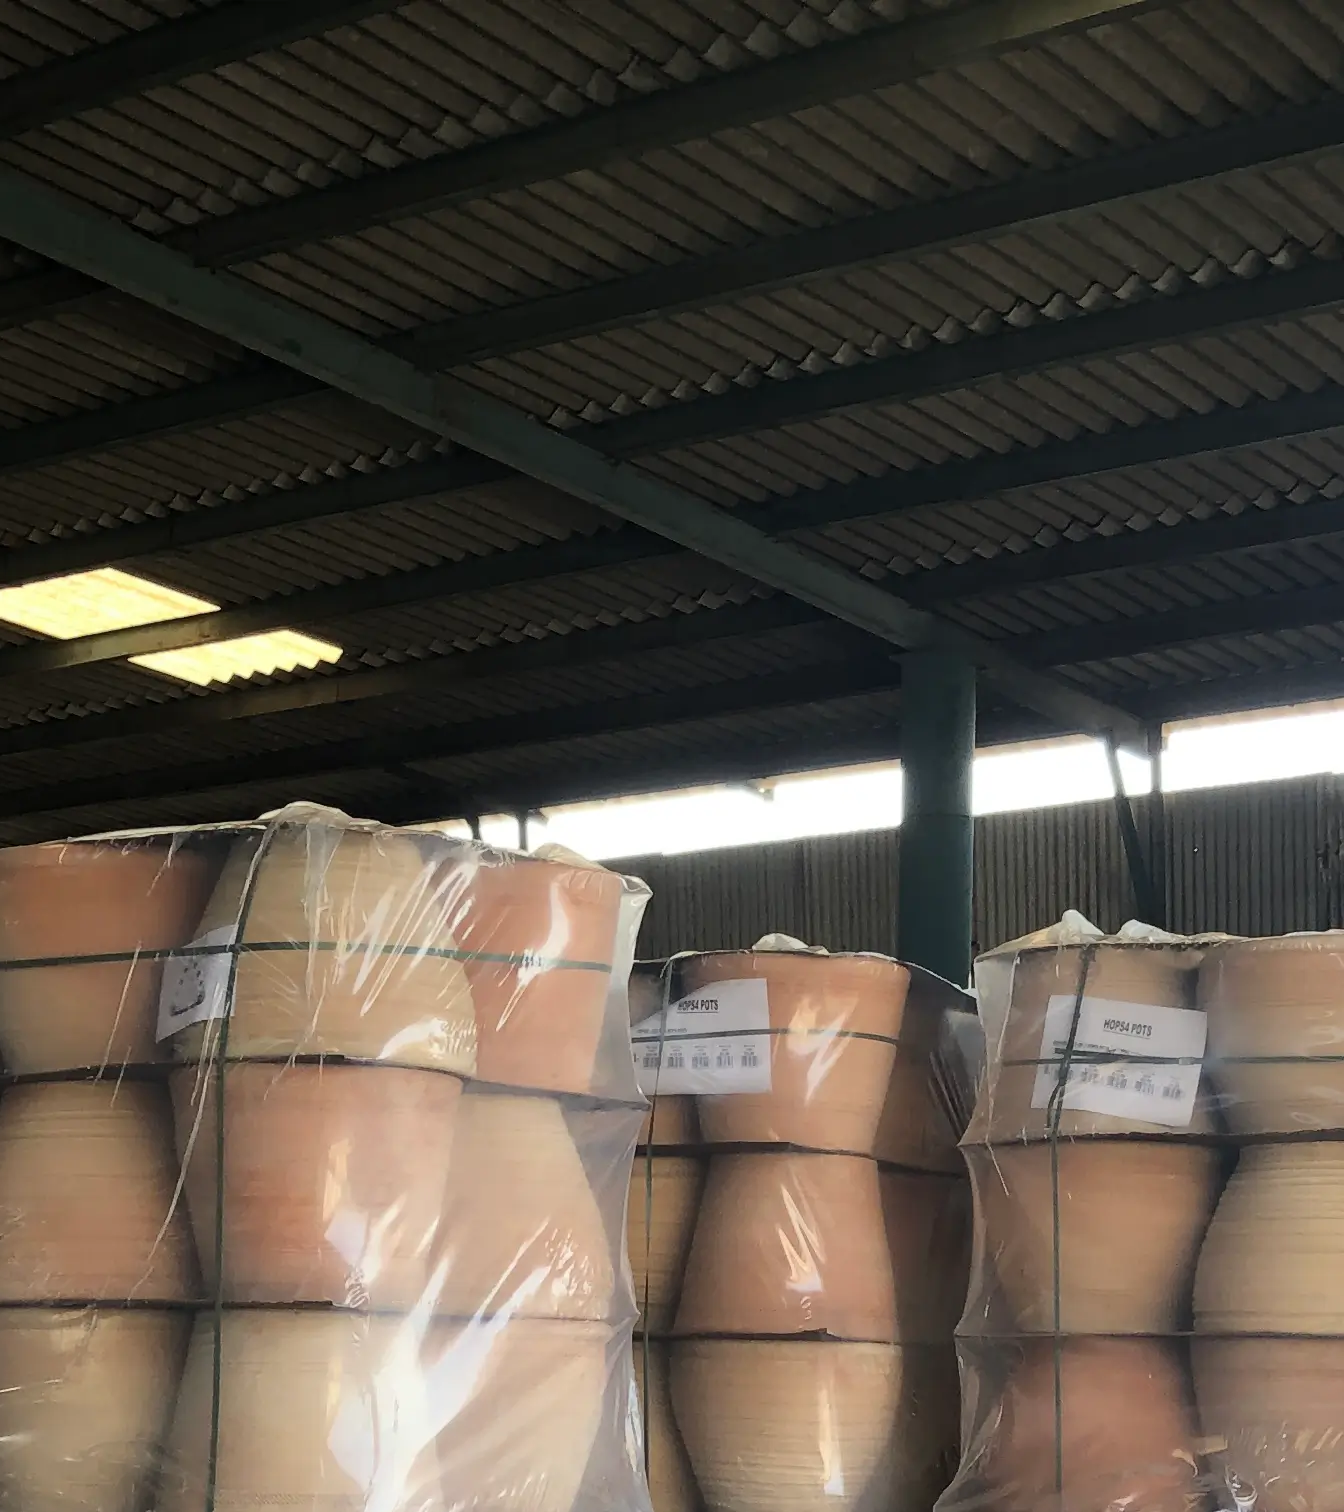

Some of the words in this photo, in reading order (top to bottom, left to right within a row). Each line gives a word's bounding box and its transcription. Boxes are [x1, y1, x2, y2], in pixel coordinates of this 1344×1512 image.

[700, 999, 719, 1011] POTS
[1103, 1019, 1129, 1032] HOPS4
[1130, 1023, 1153, 1037] POTS
